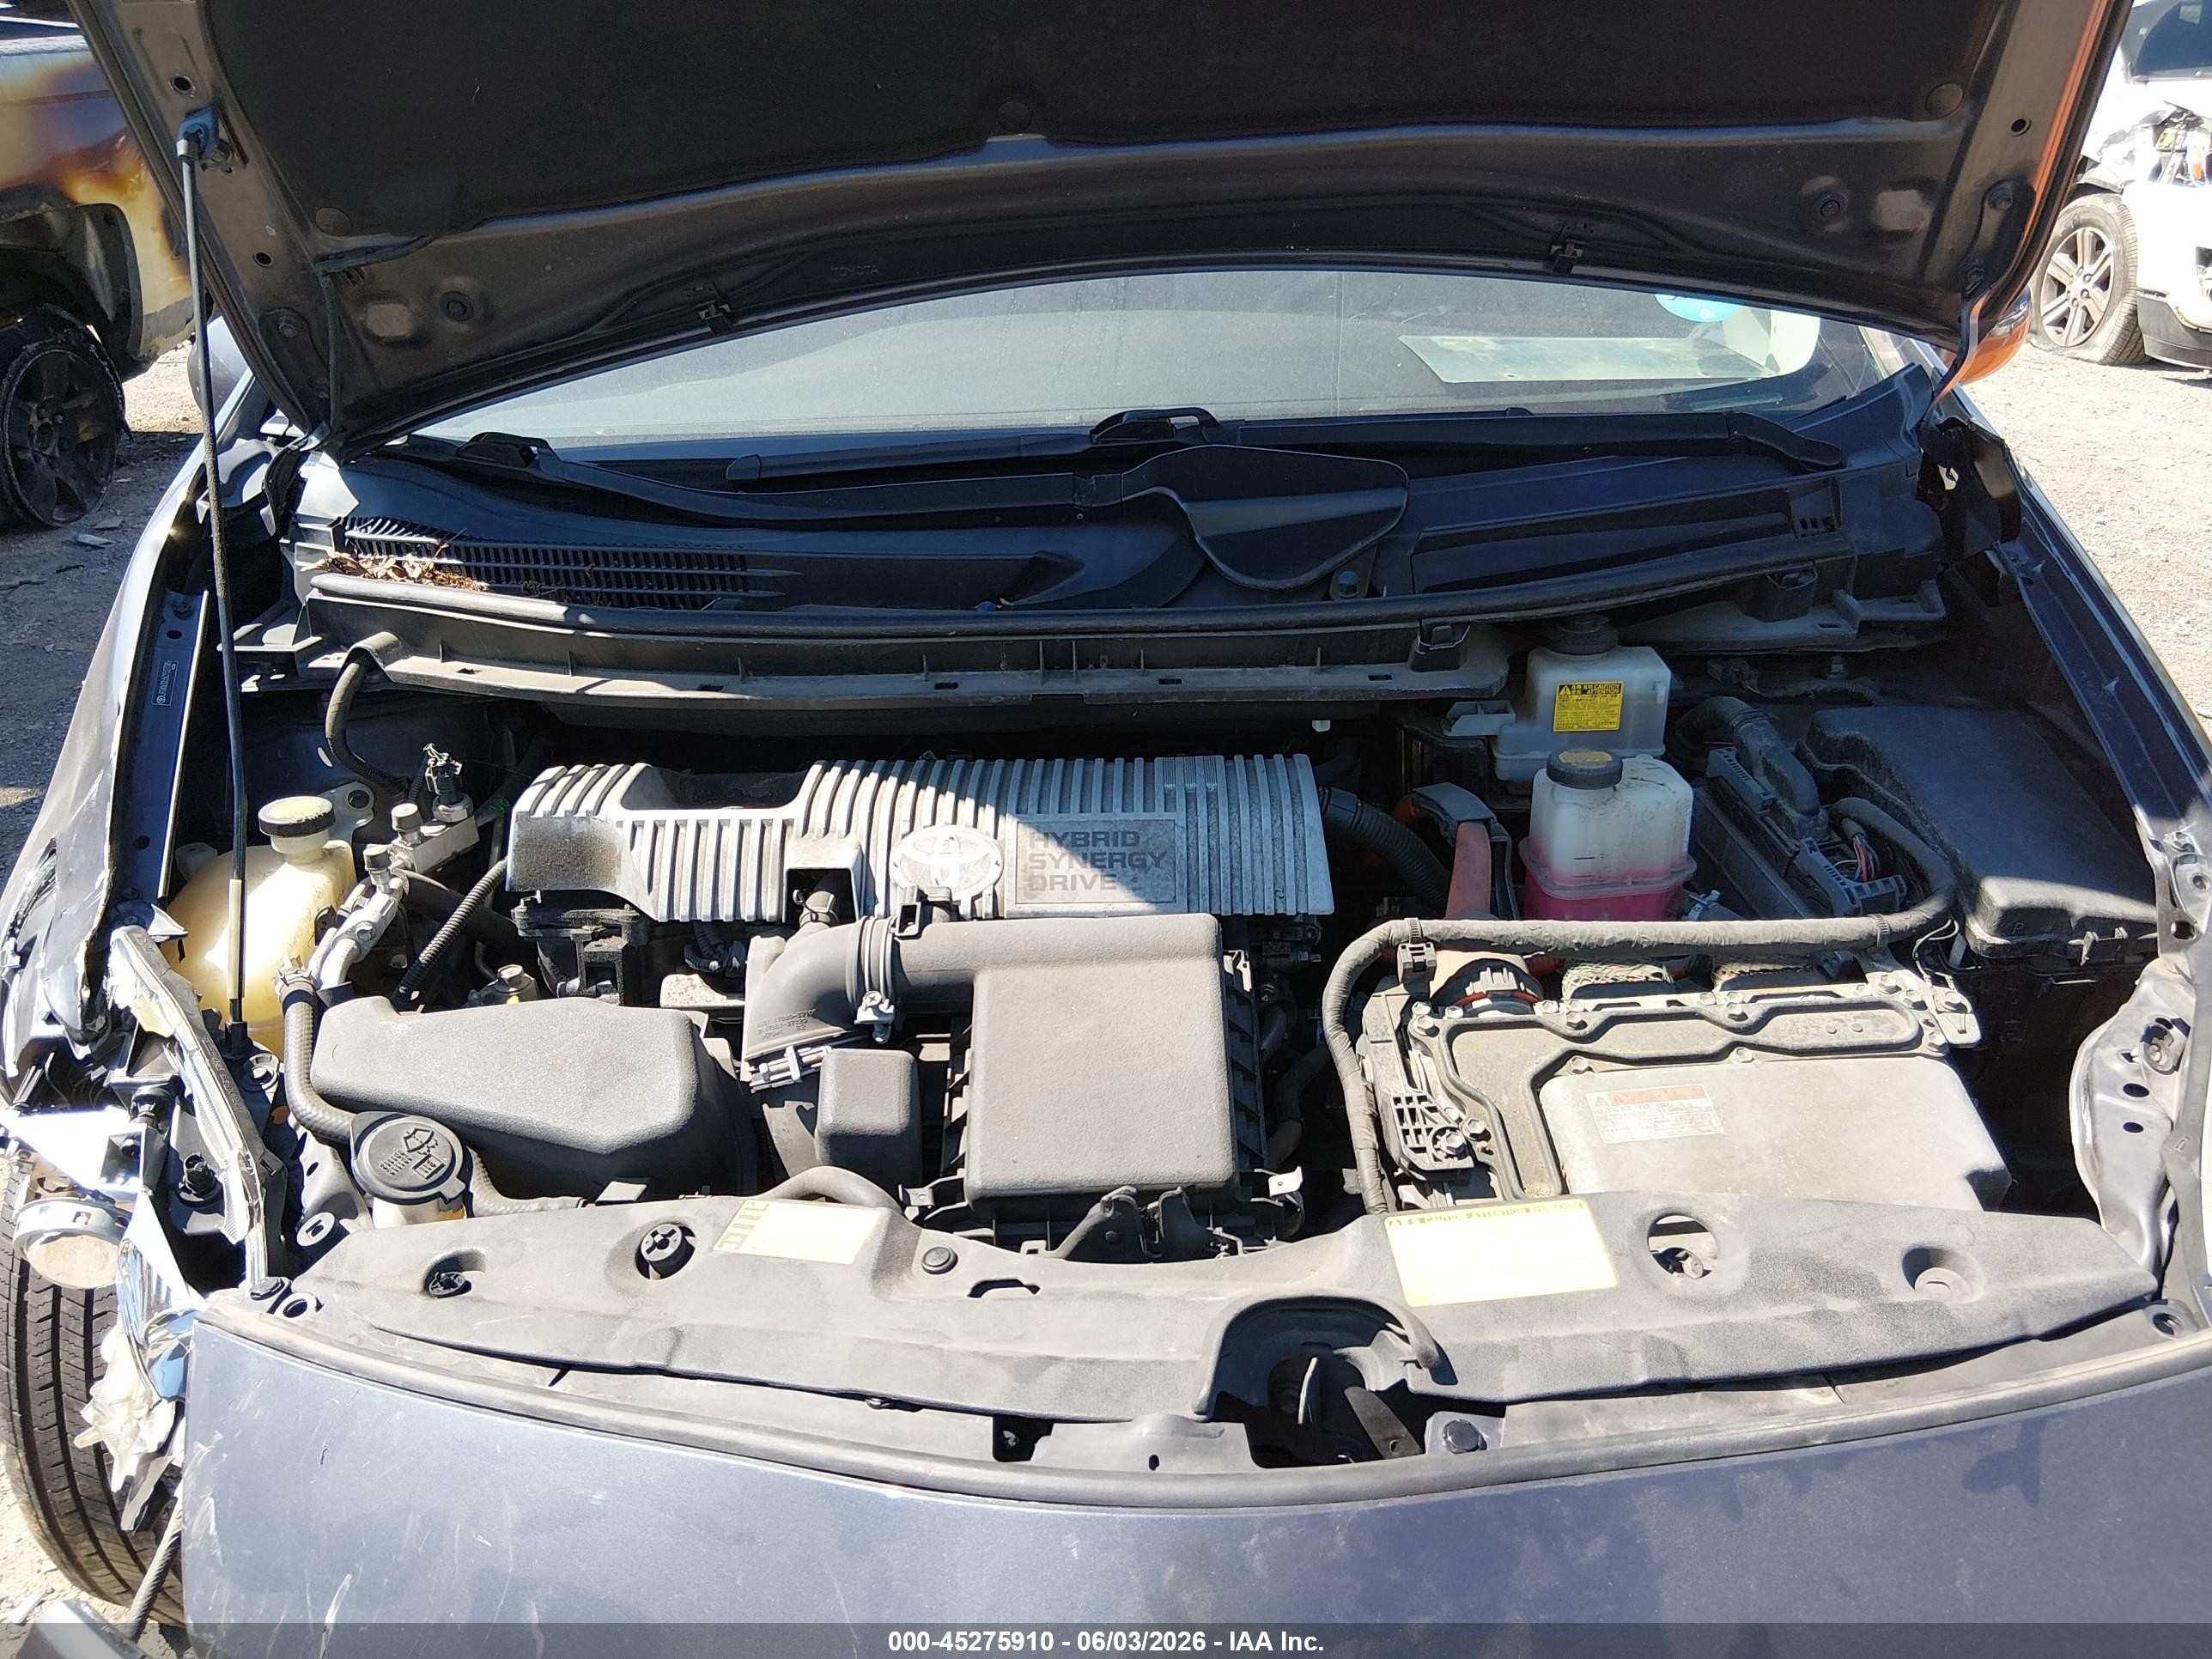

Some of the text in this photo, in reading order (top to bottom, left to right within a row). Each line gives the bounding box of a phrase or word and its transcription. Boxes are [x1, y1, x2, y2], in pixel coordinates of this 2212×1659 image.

[831, 264, 881, 276] TOYOTA
[1029, 830, 1139, 848] HYBRID
[1029, 851, 1168, 870] SYNERGY
[1029, 873, 1117, 891] DRIVE
